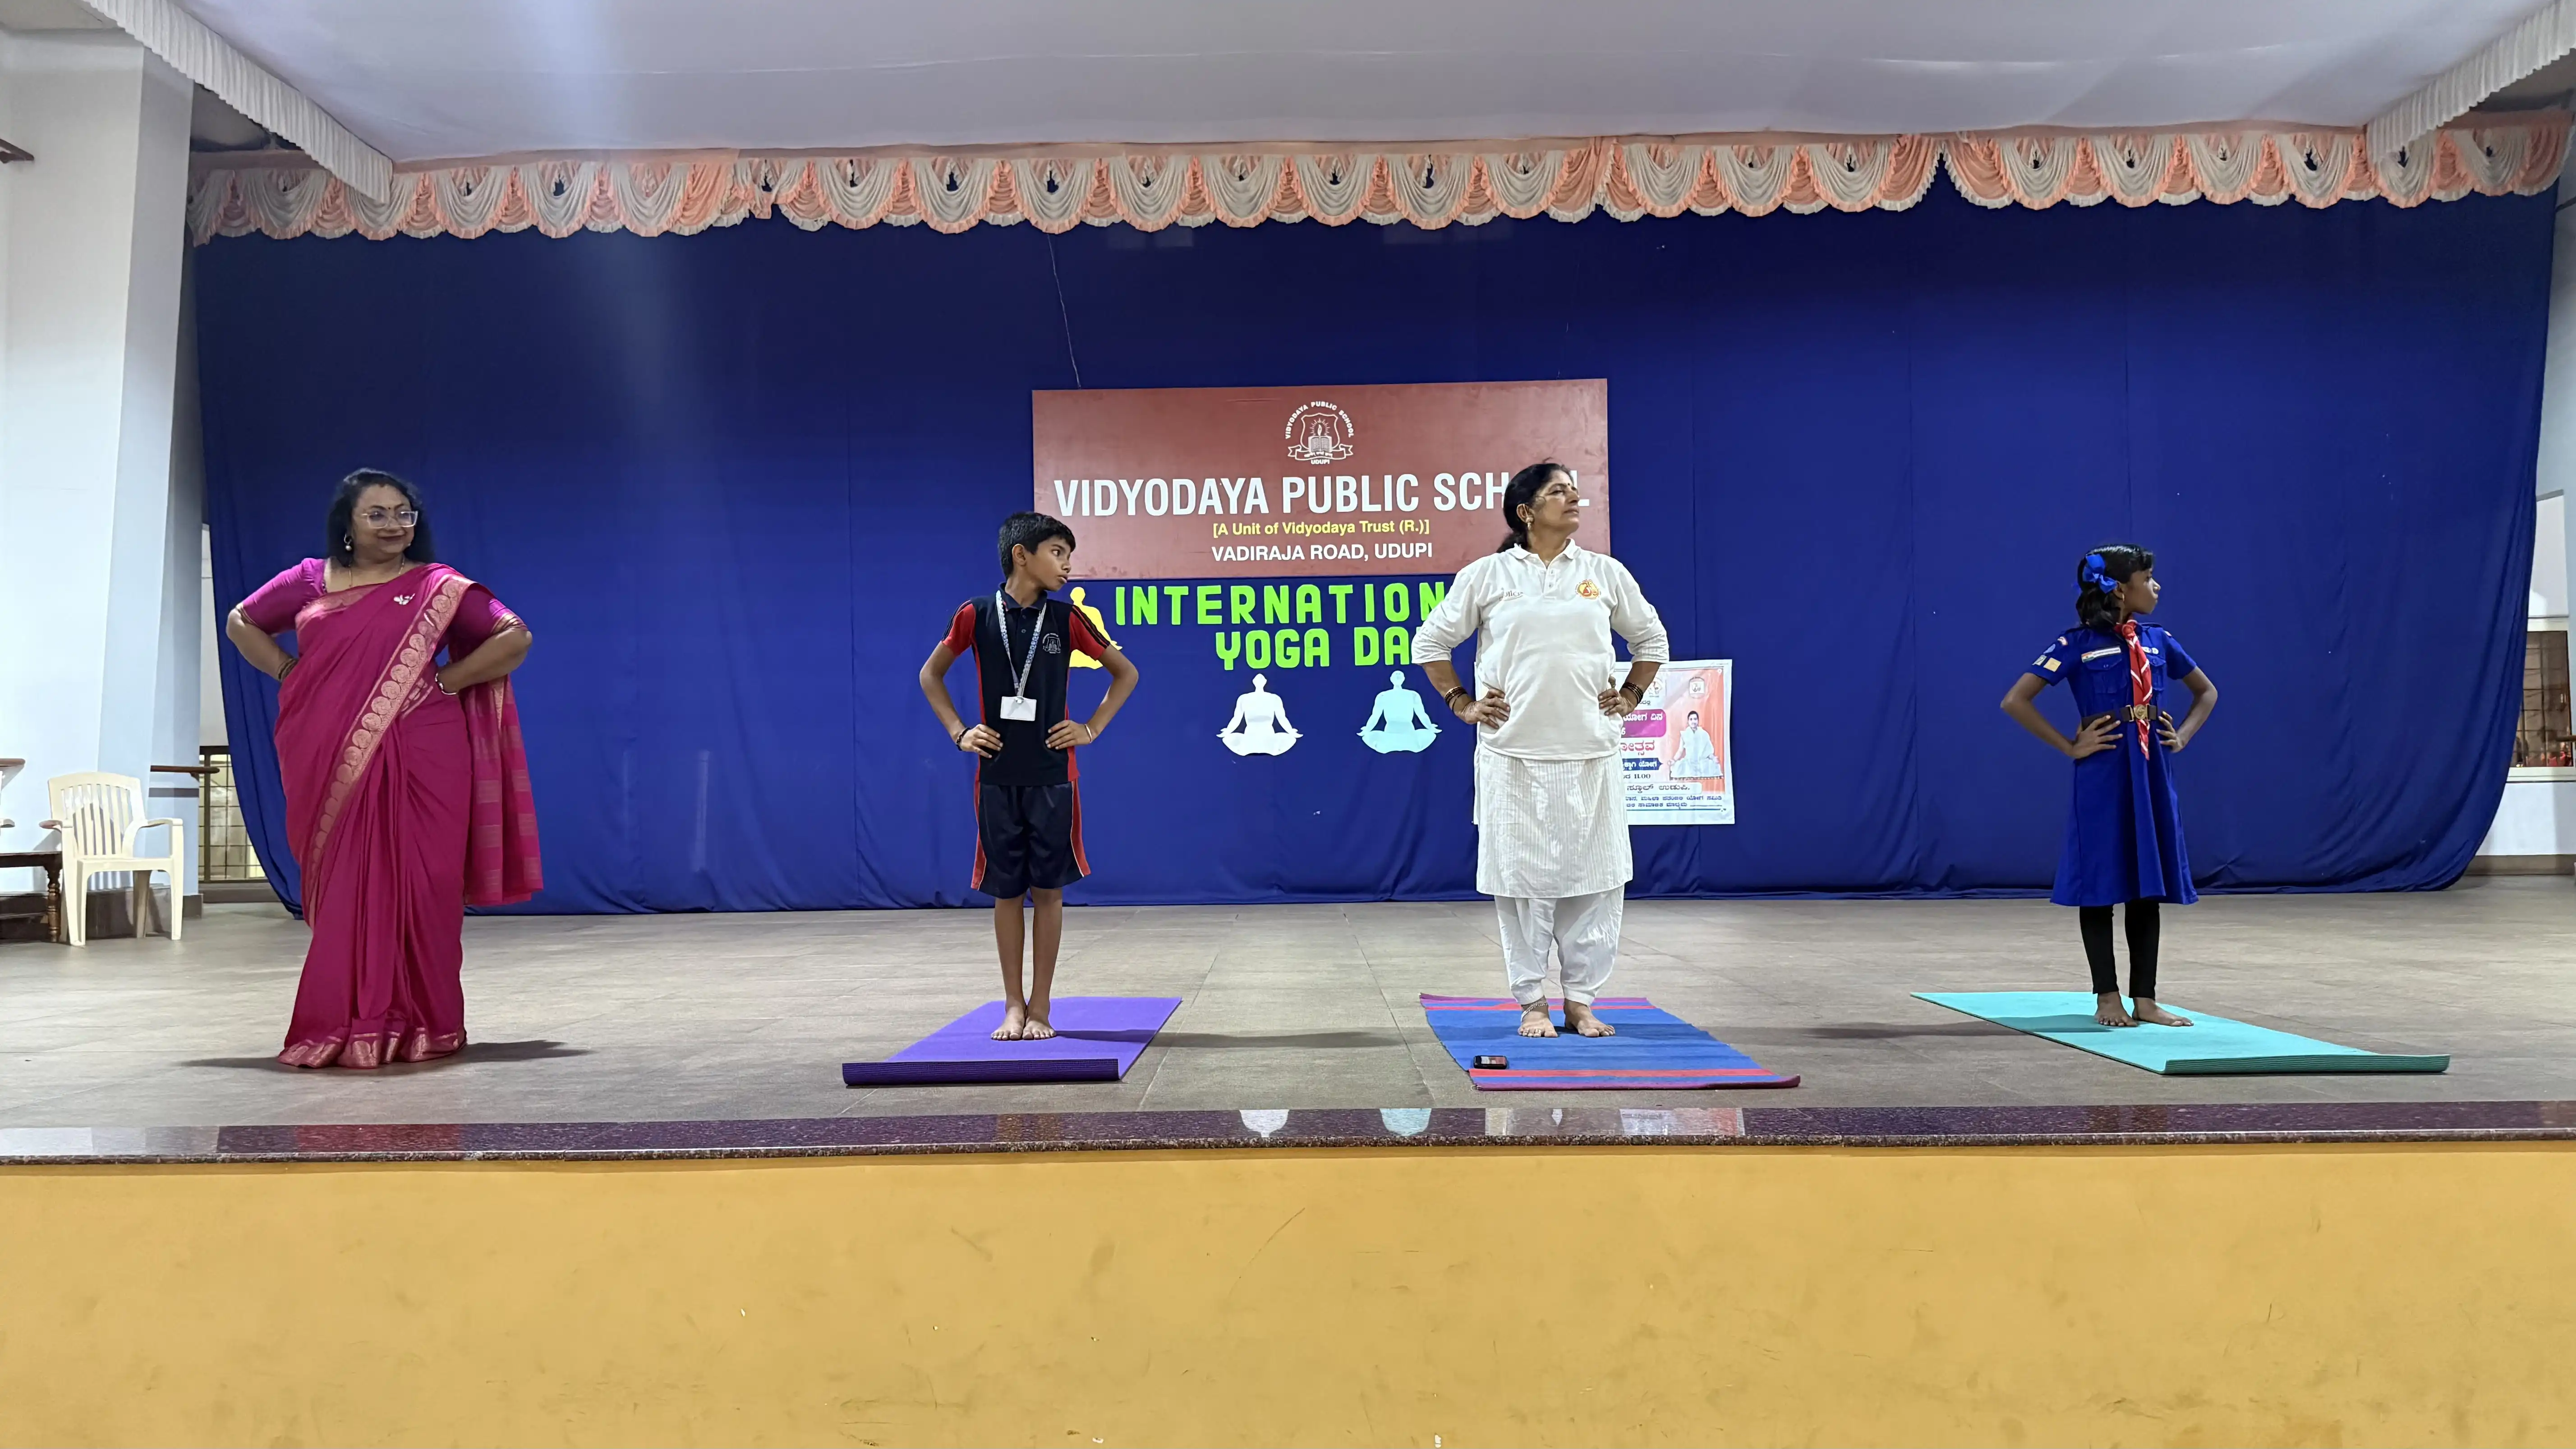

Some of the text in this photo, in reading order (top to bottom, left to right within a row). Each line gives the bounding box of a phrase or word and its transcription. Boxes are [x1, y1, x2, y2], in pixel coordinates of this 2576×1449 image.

[1285, 401, 1354, 439] VIDYODAYA PUBLIC SCHOOL
[1053, 470, 1590, 517] VIDYODAYA PUBLIC SCHL
[1233, 522, 1261, 536] Unit
[1265, 522, 1280, 535] of
[1282, 521, 1356, 538] Vidyodaya
[1359, 520, 1395, 534] Trust
[1399, 520, 1430, 535] (R.)]
[1211, 542, 1433, 562] VADIRAJA ROAD, UDUPI
[1116, 582, 1444, 626] INTERNATION
[1216, 626, 1421, 671] YOGA DA
